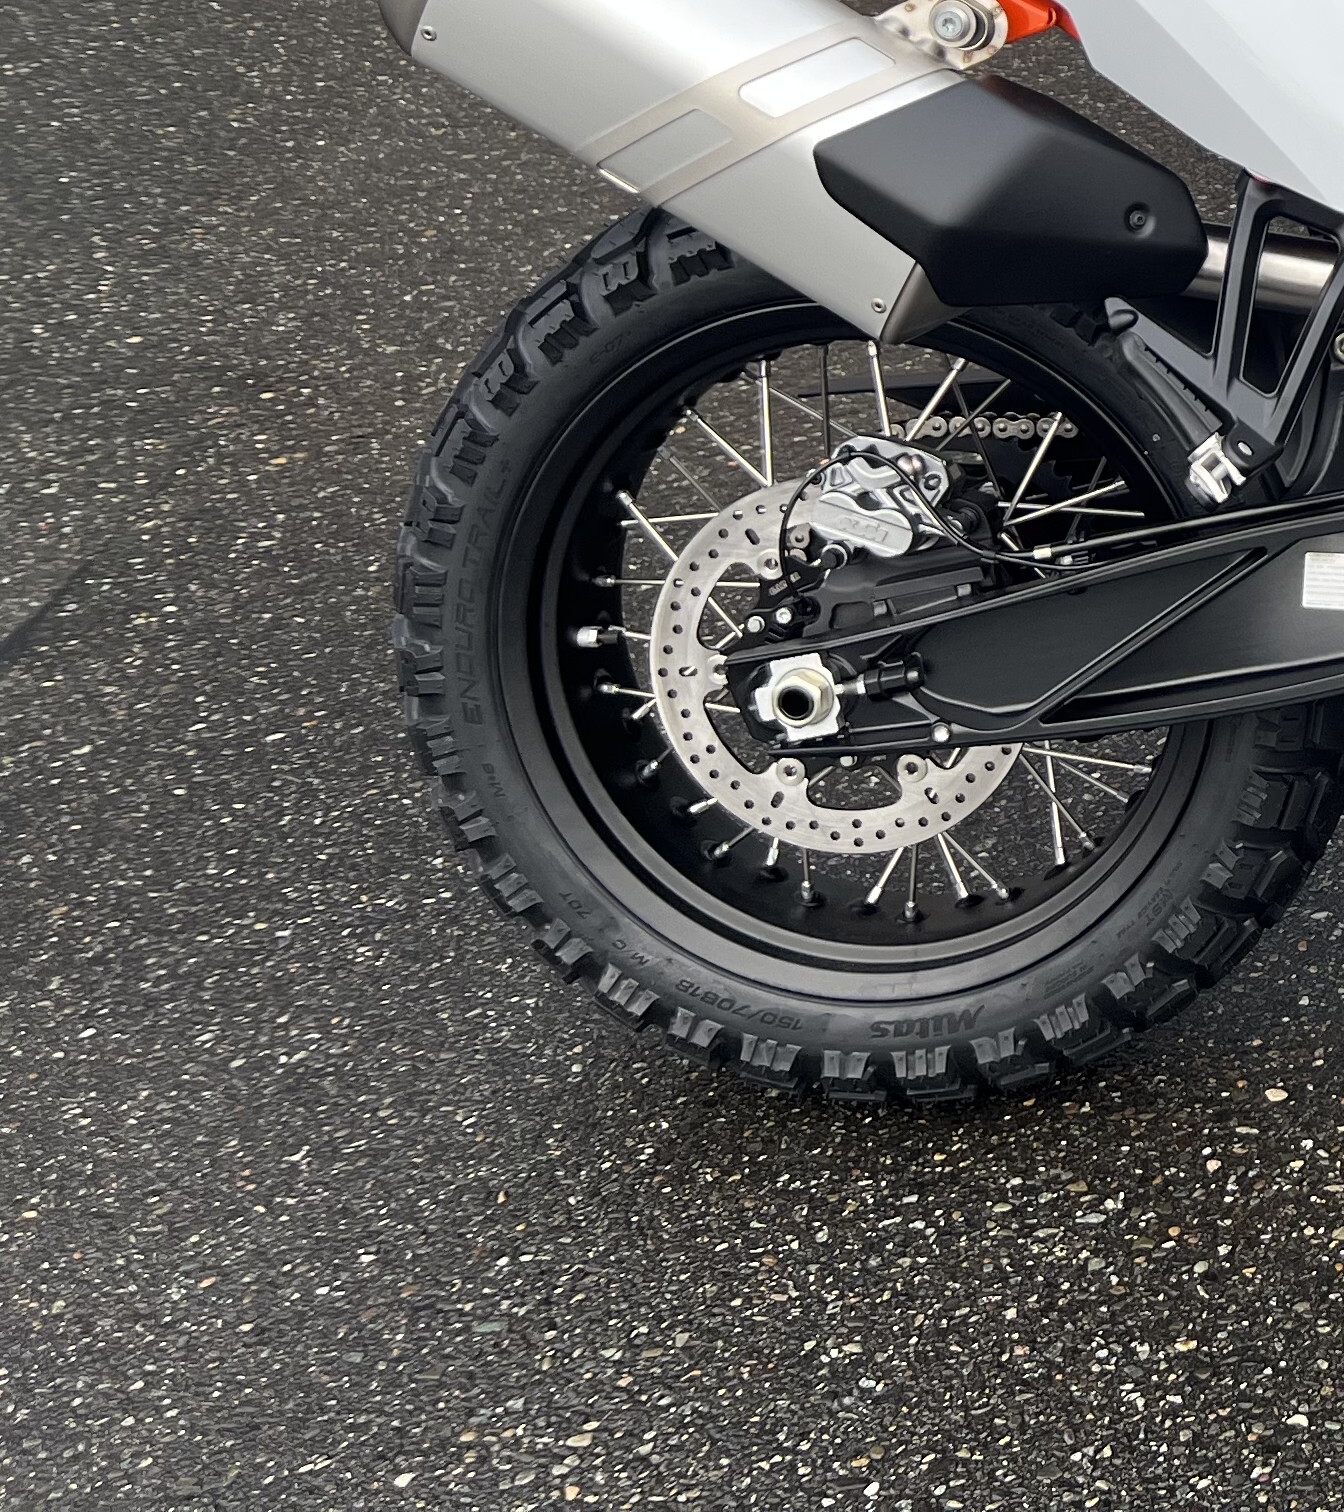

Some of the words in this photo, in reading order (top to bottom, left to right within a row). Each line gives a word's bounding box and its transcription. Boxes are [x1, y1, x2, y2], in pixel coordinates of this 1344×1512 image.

[454, 577, 484, 727] ENDURO
[674, 978, 804, 1032] 150/70B18
[870, 1003, 986, 1040] Mitas
